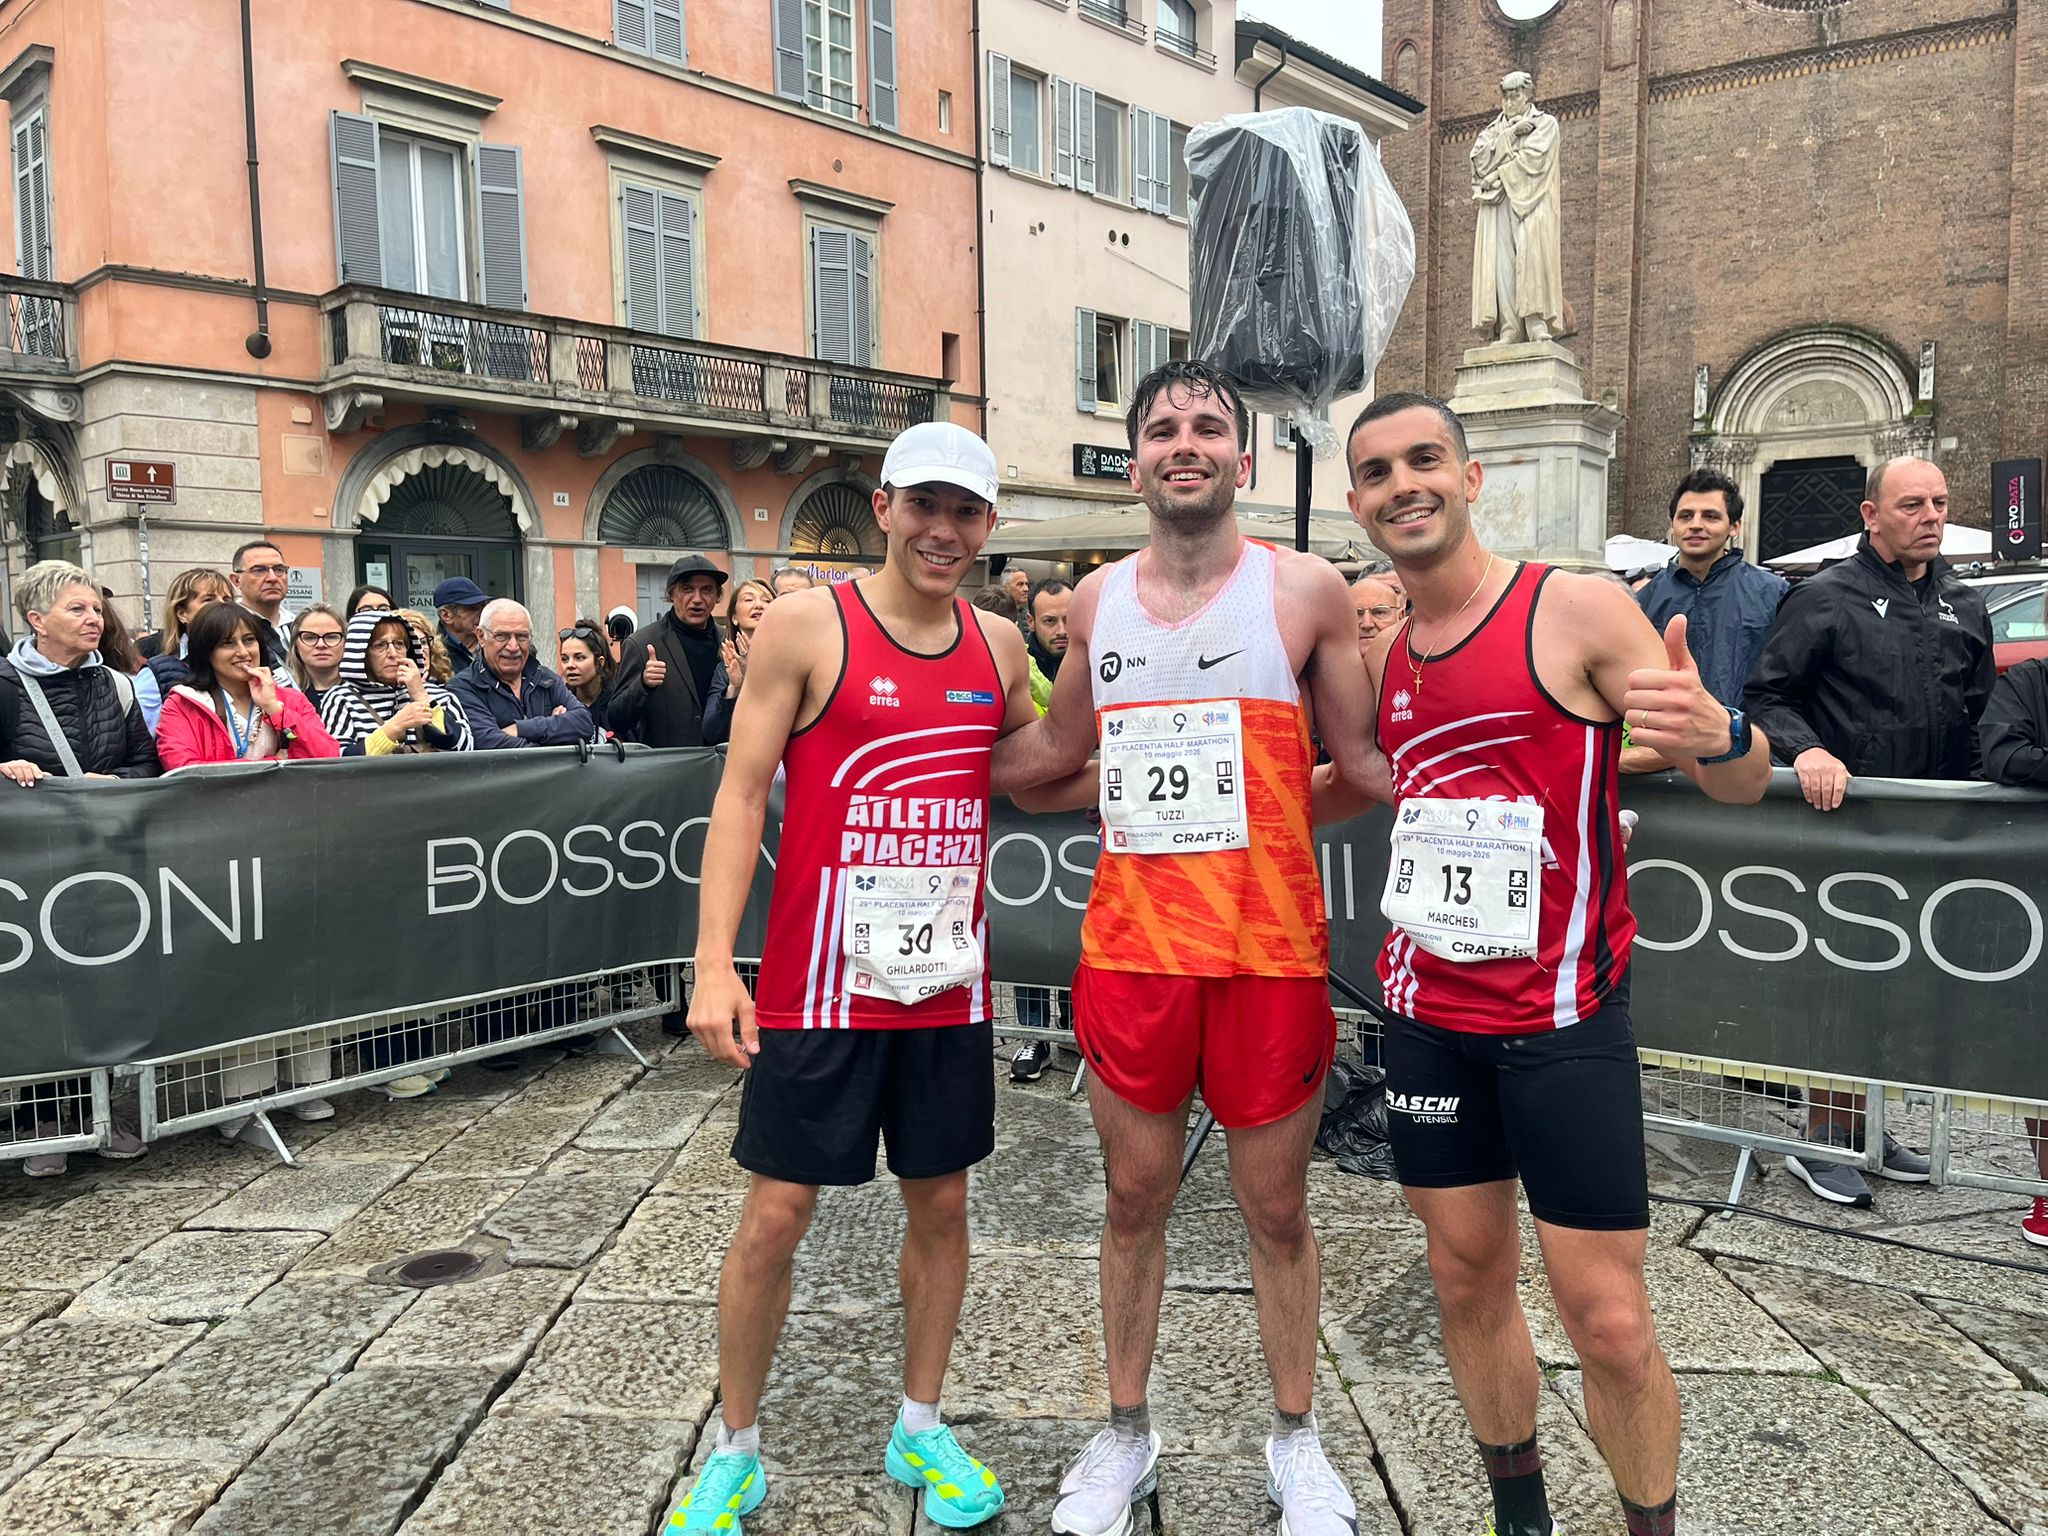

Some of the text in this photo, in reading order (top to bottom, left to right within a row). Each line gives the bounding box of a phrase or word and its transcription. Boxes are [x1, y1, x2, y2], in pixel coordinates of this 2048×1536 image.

[2009, 477, 2018, 529] EVODATA
[808, 563, 849, 580] Marlon
[1127, 656, 1146, 668] NN
[1122, 742, 1162, 752] PLACENTIA
[1164, 740, 1184, 749] HALF
[1187, 737, 1229, 747] MARATHON
[1154, 751, 1182, 759] maggio
[1147, 764, 1189, 801] 29
[845, 795, 982, 829] ATLETICA
[1156, 810, 1185, 821] TUZZI
[1514, 816, 1529, 828] PHM
[1172, 832, 1223, 843] CRAFT
[1416, 836, 1454, 846] PLACENTIA
[1456, 840, 1474, 848] HALF
[1476, 842, 1526, 852] MARATHON
[1446, 849, 1472, 858] maggio
[427, 817, 782, 915] BOSSO
[1442, 864, 1472, 905] 13
[1428, 912, 1478, 928] MARCHESI
[1627, 858, 2044, 982] OSSO
[898, 923, 933, 955] 30
[1452, 942, 1509, 956] CRAFT
[887, 962, 948, 975] GHILARDOTTI
[1385, 1086, 1460, 1111] RASCHI
[1412, 1115, 1458, 1123] UTENSILI
